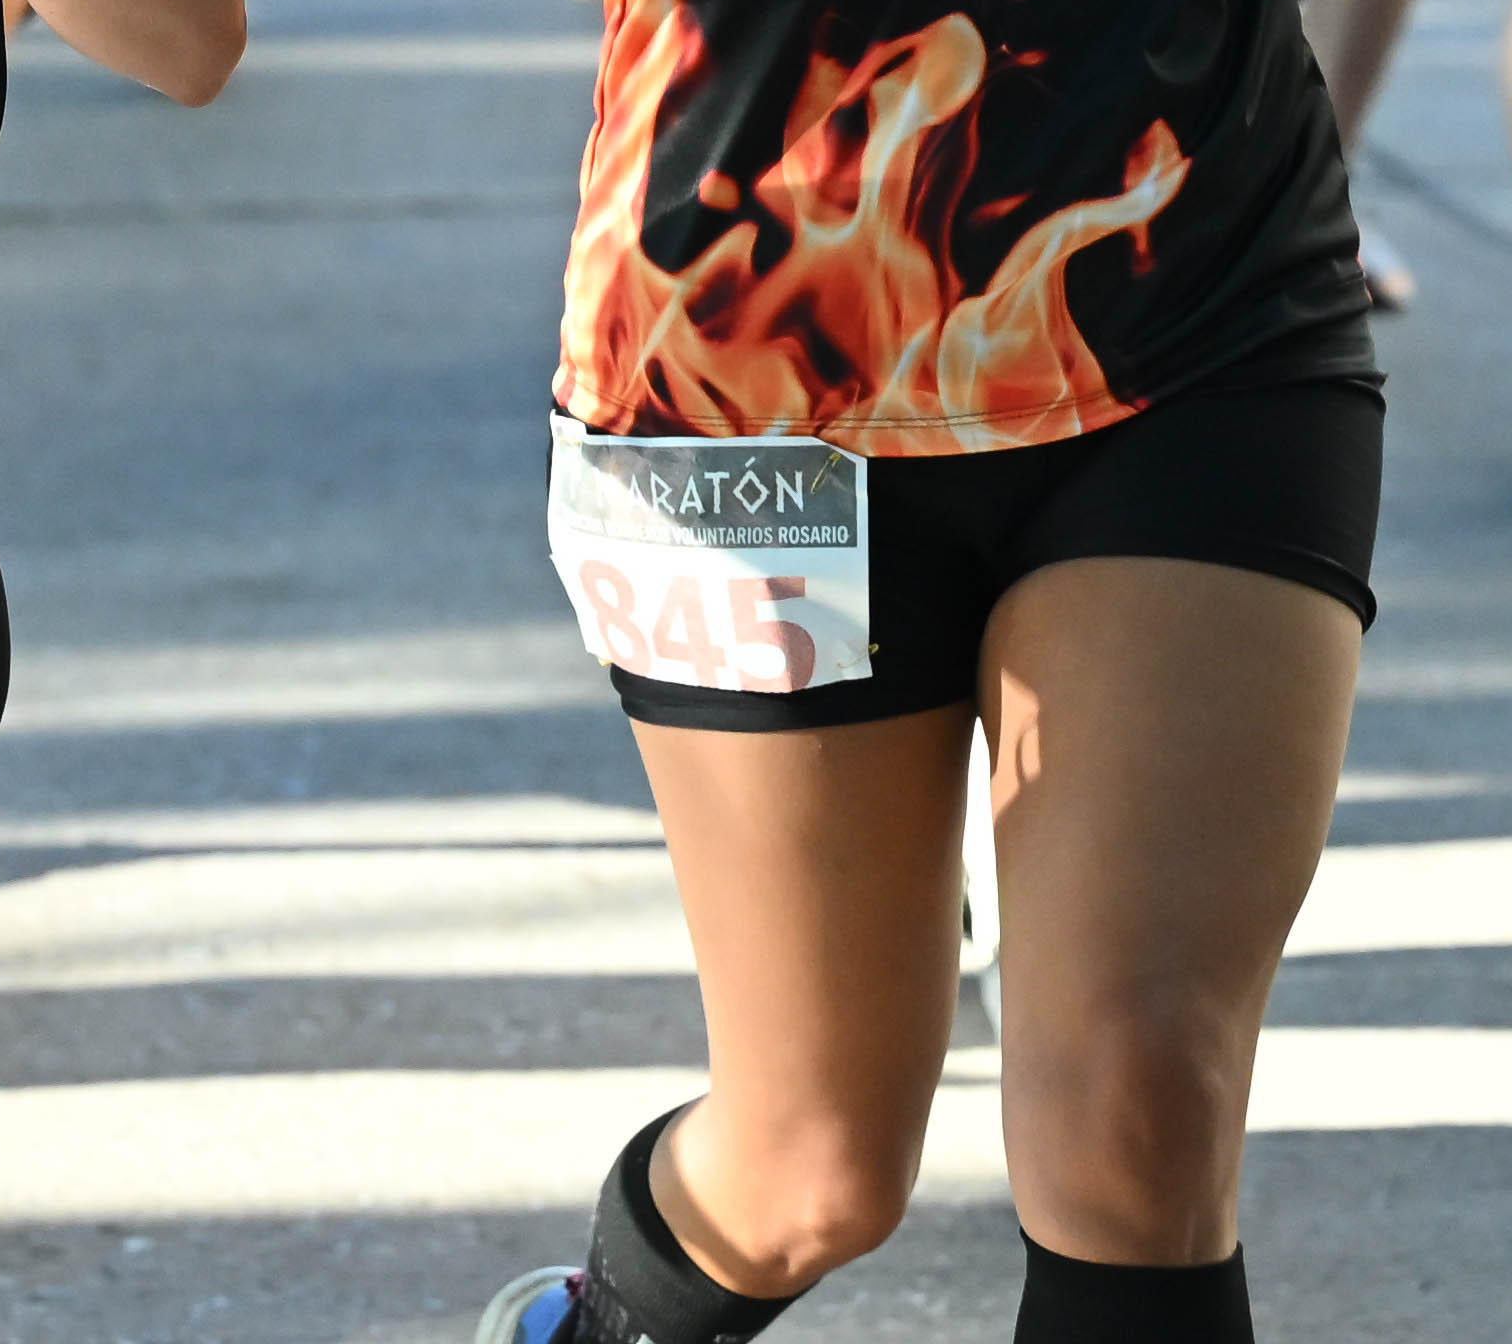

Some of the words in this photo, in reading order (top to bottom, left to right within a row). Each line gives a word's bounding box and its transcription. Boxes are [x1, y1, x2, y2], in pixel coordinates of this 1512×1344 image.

[624, 456, 804, 515] ARATÓN
[778, 525, 850, 545] ROSARIO
[578, 559, 816, 694] 845
